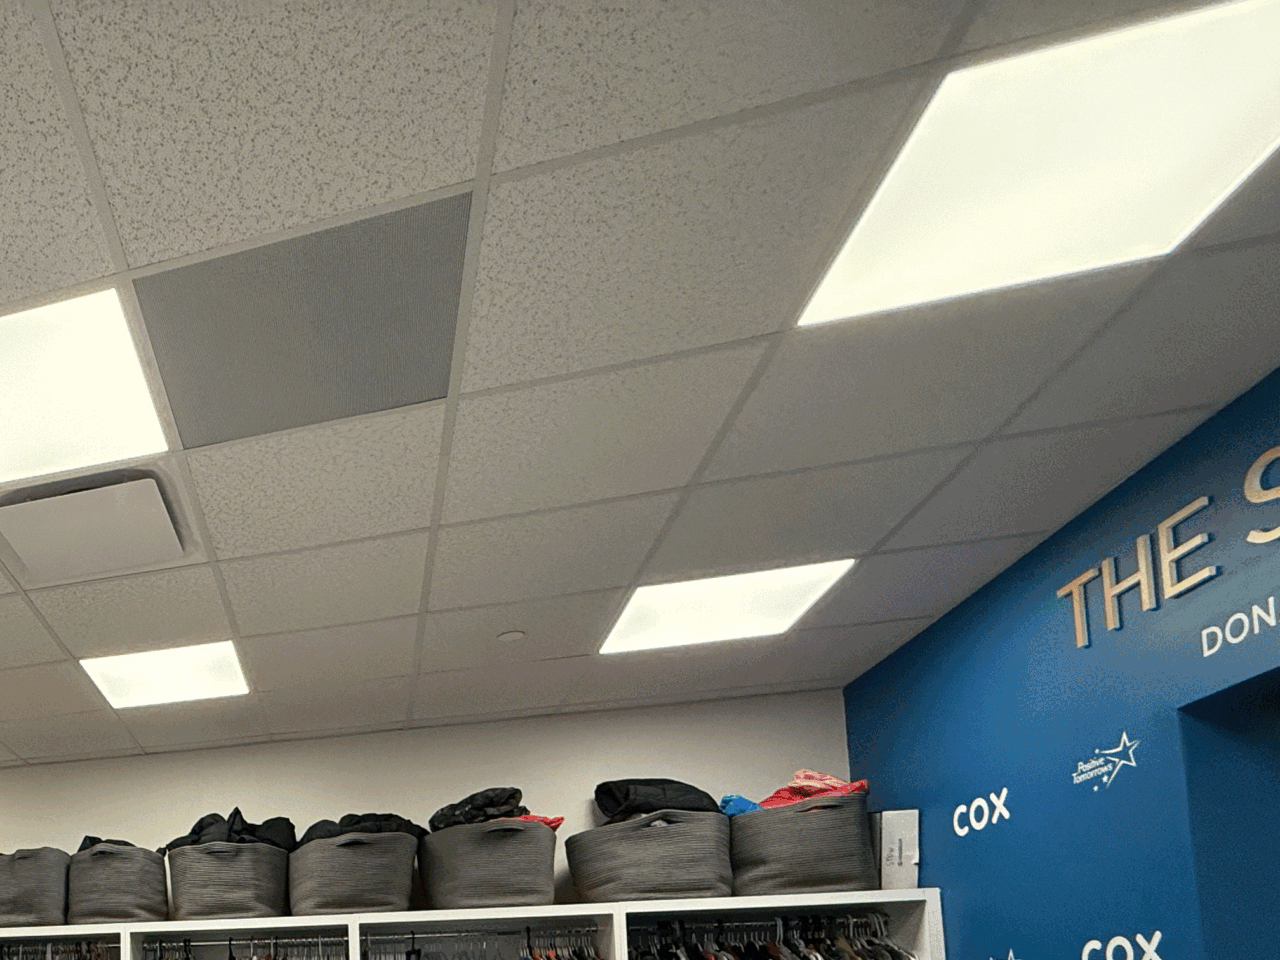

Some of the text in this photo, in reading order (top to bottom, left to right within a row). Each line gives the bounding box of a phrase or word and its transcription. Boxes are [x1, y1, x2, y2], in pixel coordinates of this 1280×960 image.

[1056, 496, 1217, 649] THE
[1071, 762, 1114, 784] Tomorrows
[1077, 757, 1105, 774] Positive
[952, 786, 1011, 837] COX
